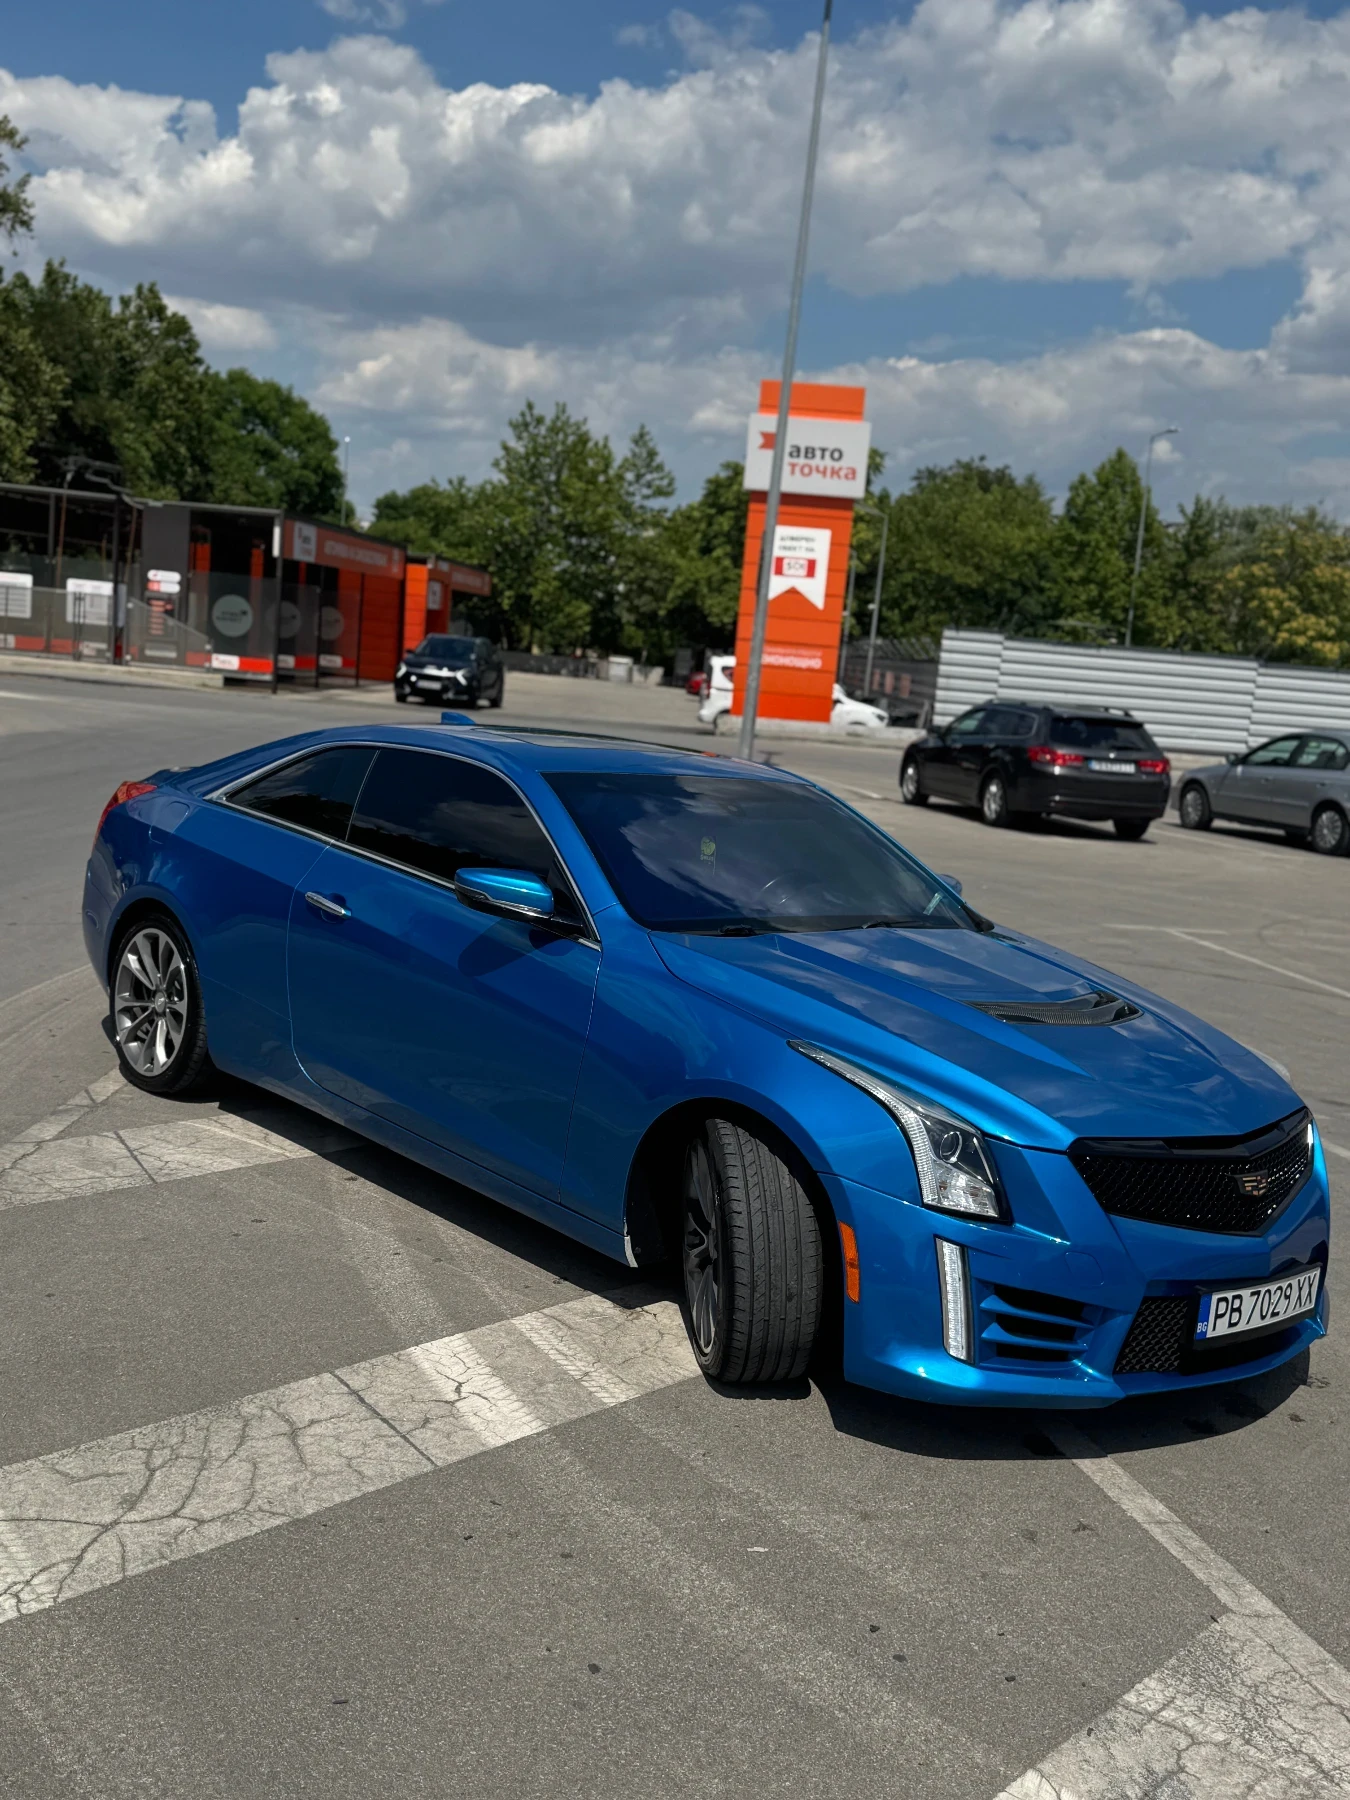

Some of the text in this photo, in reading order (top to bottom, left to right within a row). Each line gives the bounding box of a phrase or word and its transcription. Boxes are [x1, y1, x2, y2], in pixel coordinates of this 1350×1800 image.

[788, 444, 844, 462] авто
[788, 462, 857, 481] точка
[1211, 1273, 1317, 1332] PB 7029 XX
[1196, 1322, 1208, 1333] BG
